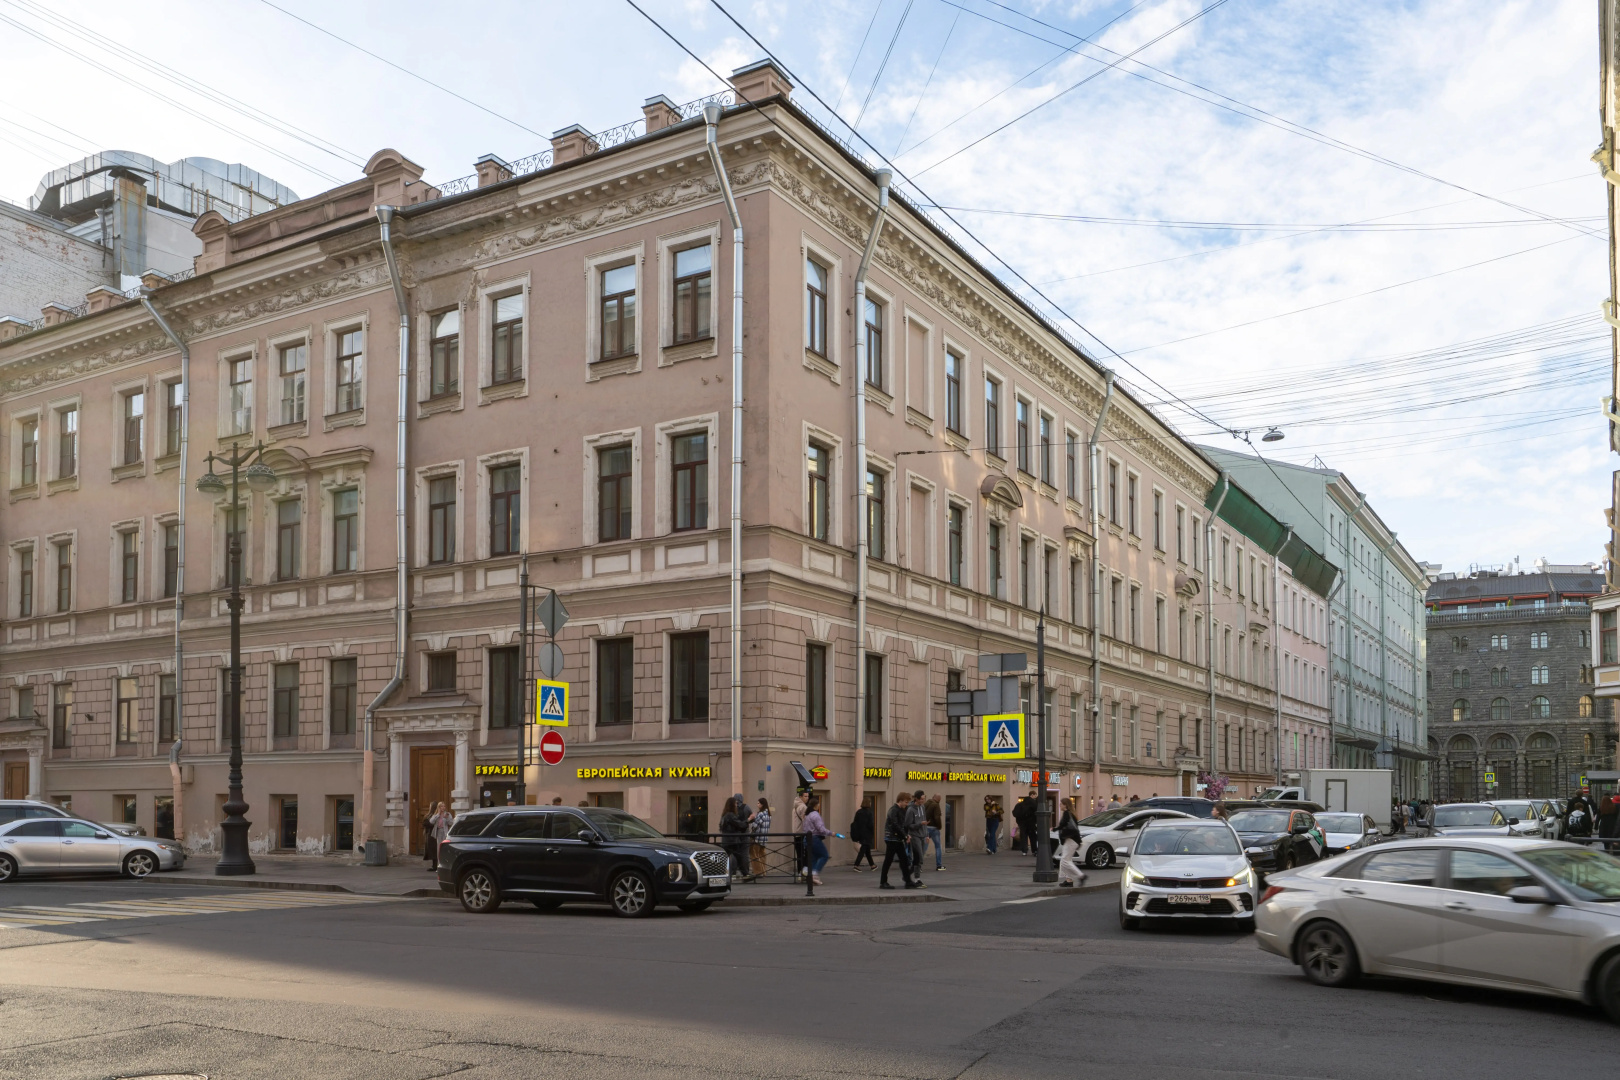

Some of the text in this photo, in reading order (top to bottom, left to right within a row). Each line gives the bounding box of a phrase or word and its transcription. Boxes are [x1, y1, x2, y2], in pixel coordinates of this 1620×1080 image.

[577, 765, 711, 778] ЕВРОПЕЙСКАЯ КУХНЯ
[908, 771, 942, 780] ЯПОНСКАЯ
[949, 771, 988, 781] ЕВРОПЕЙСКАЯ
